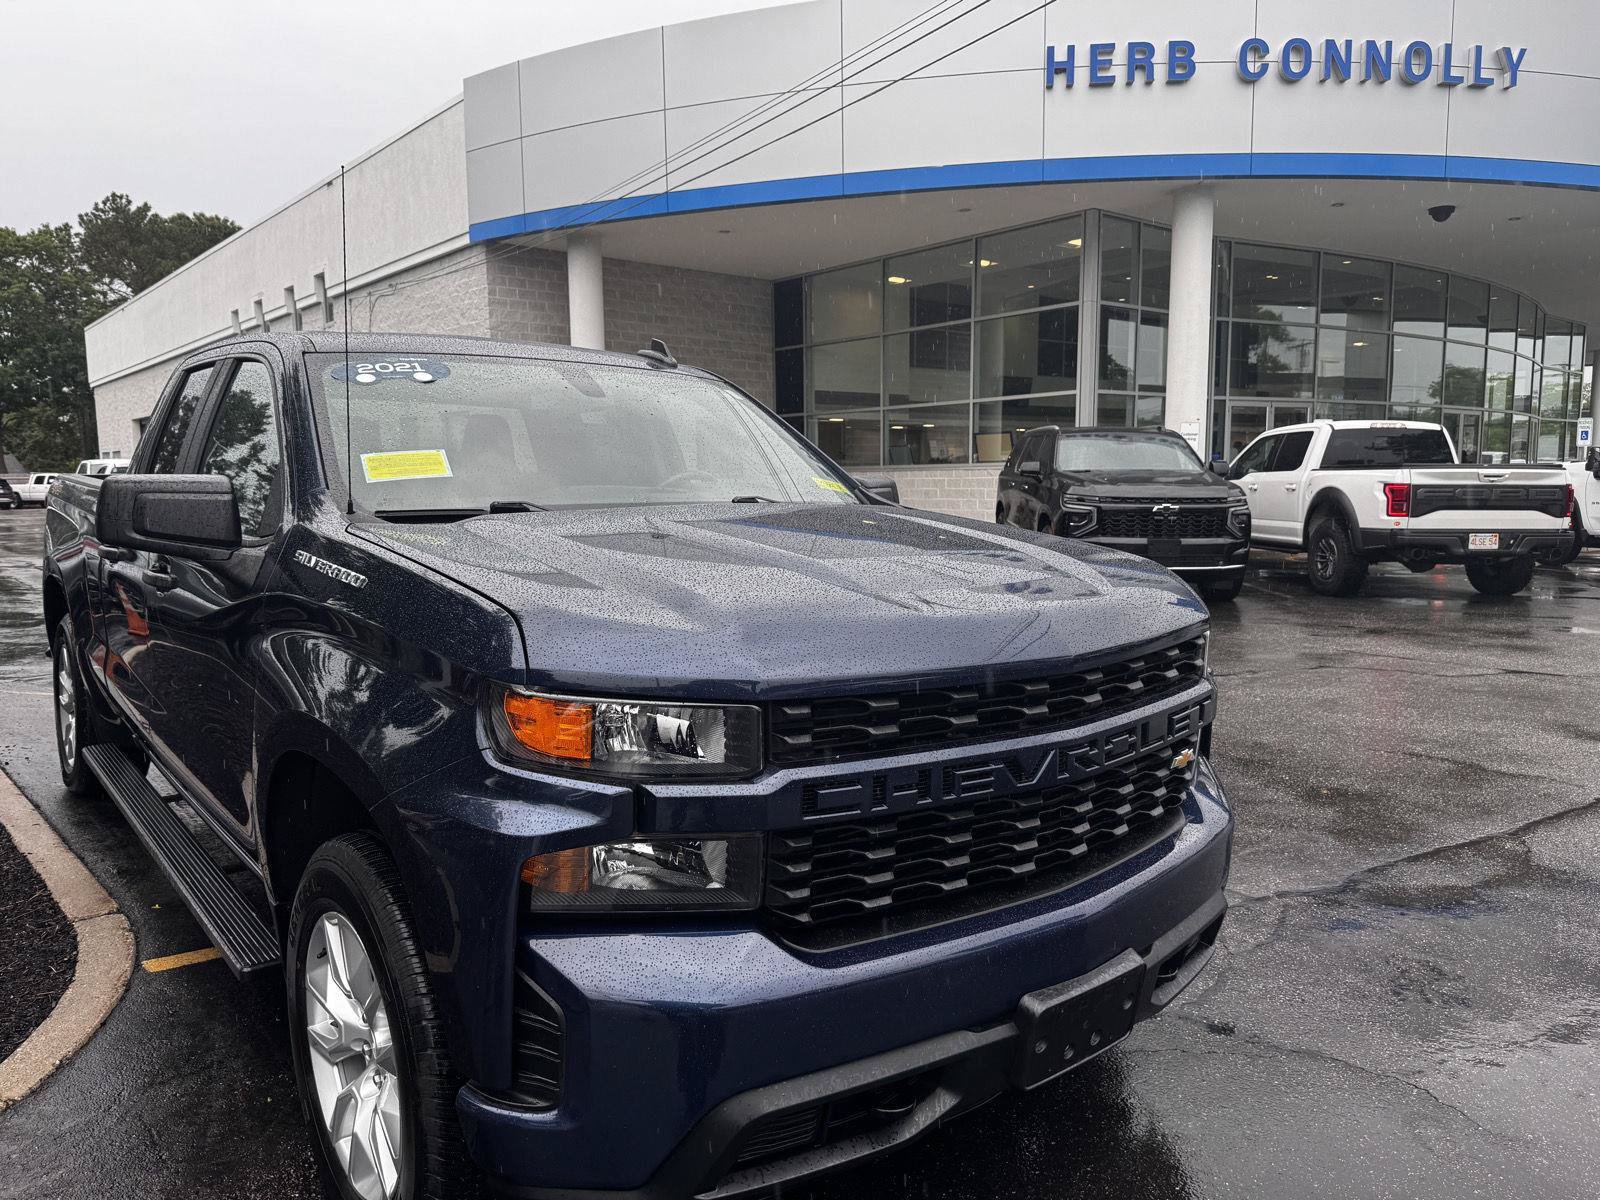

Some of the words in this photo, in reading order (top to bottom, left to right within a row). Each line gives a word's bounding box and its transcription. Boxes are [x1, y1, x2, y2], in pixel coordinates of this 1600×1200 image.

[1045, 39, 1197, 89] HERB
[1235, 37, 1529, 90] CONNOLLY
[356, 362, 426, 374] 2021
[293, 549, 369, 589] SILVERADO
[802, 701, 1213, 820] CHEVROLET
